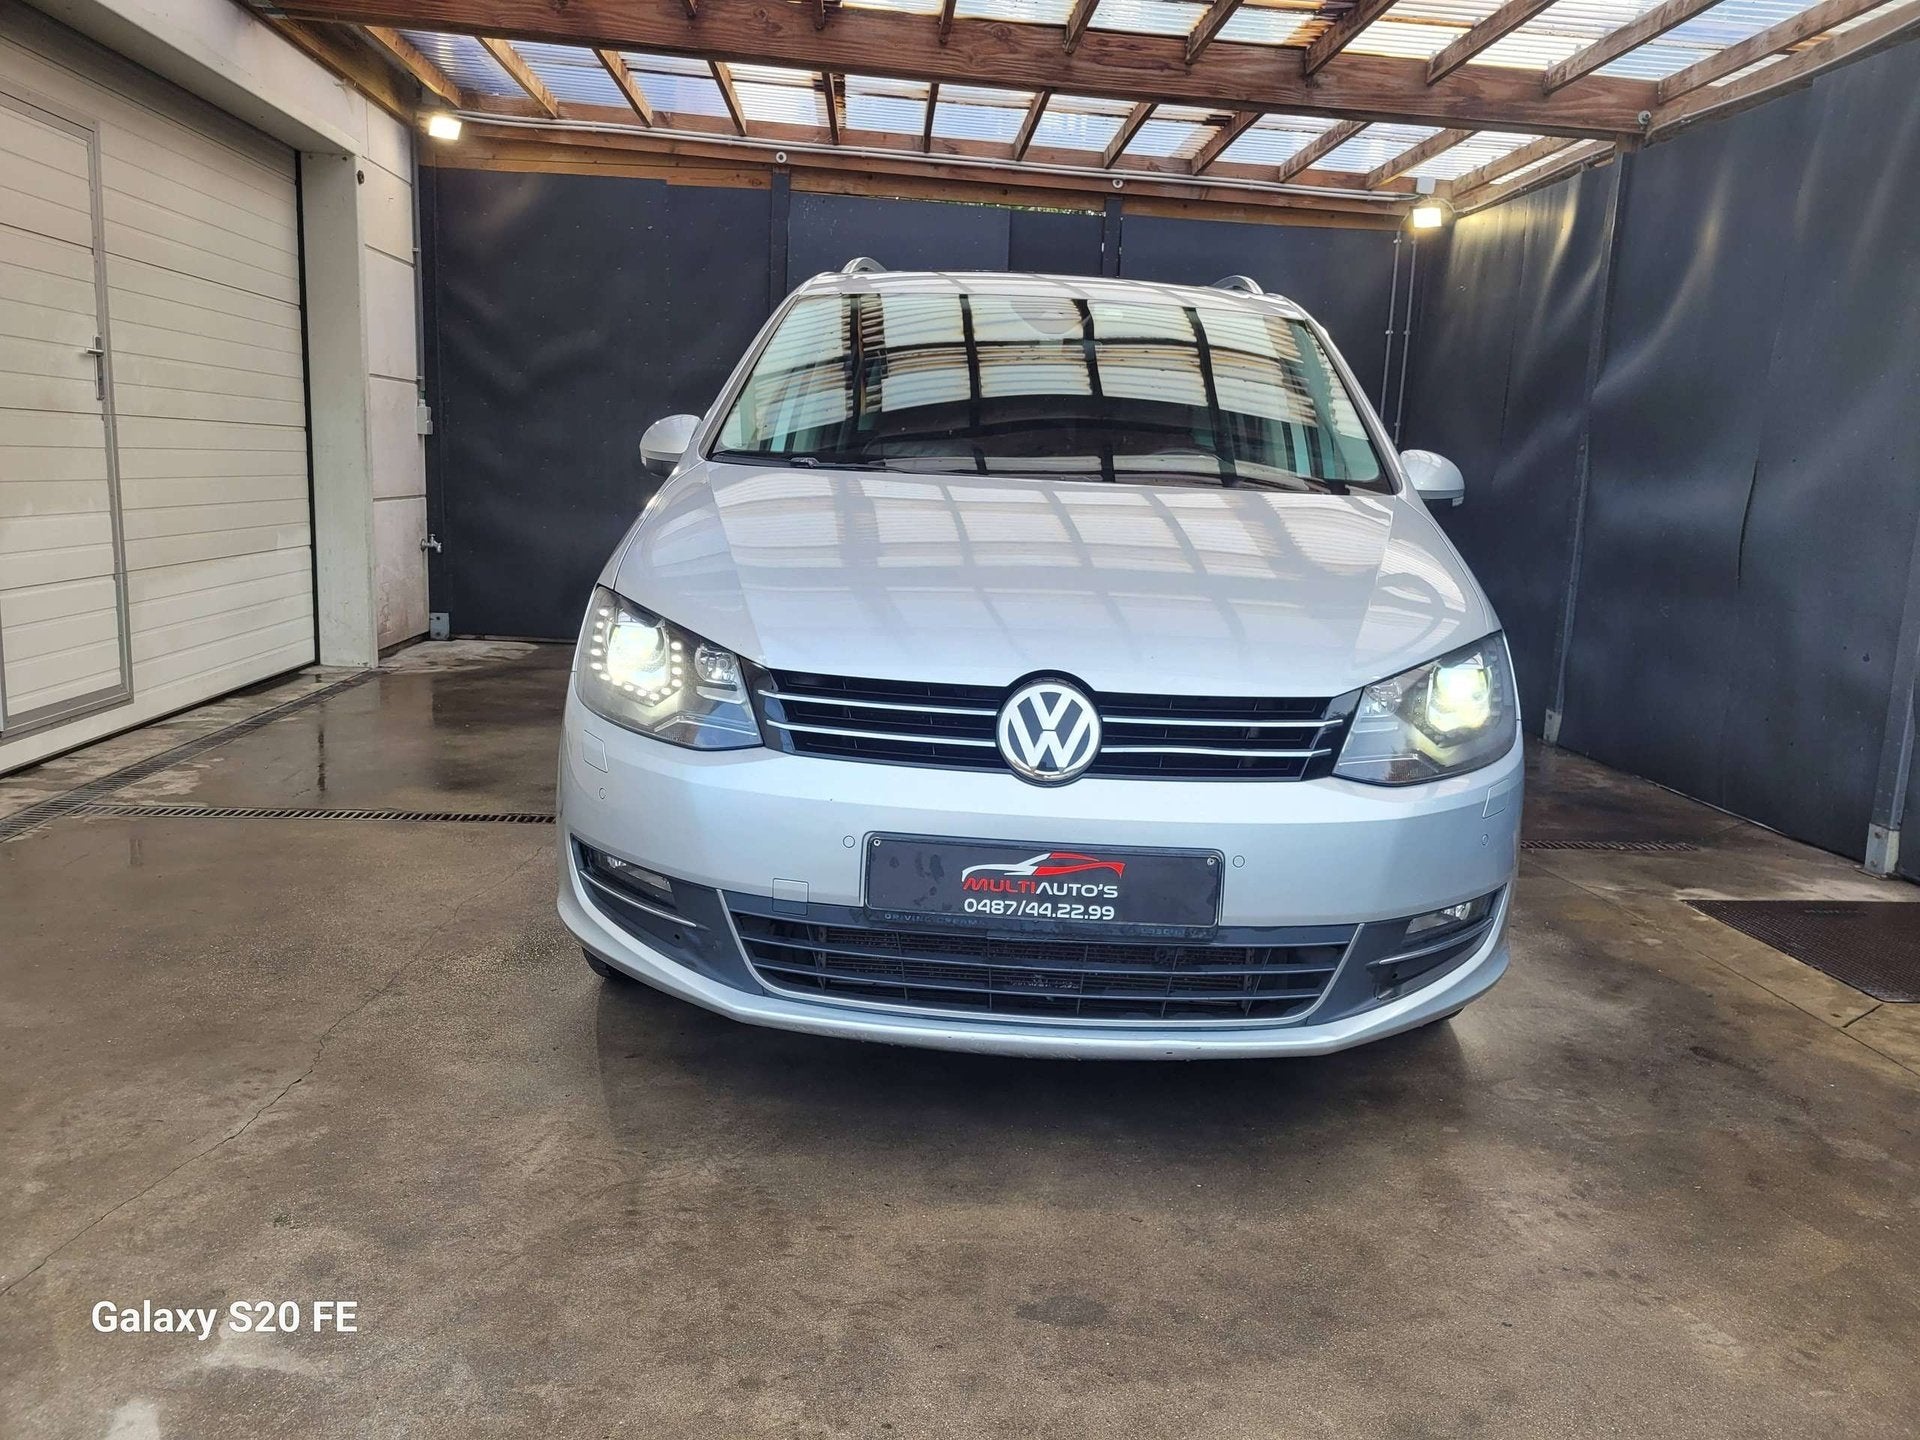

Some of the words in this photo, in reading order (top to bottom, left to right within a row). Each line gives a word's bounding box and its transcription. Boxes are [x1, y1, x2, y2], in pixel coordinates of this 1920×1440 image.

[999, 682, 1099, 776] VW
[963, 877, 1118, 898] MULTIAUTO'S
[963, 898, 1115, 920] 0487/44.22.99
